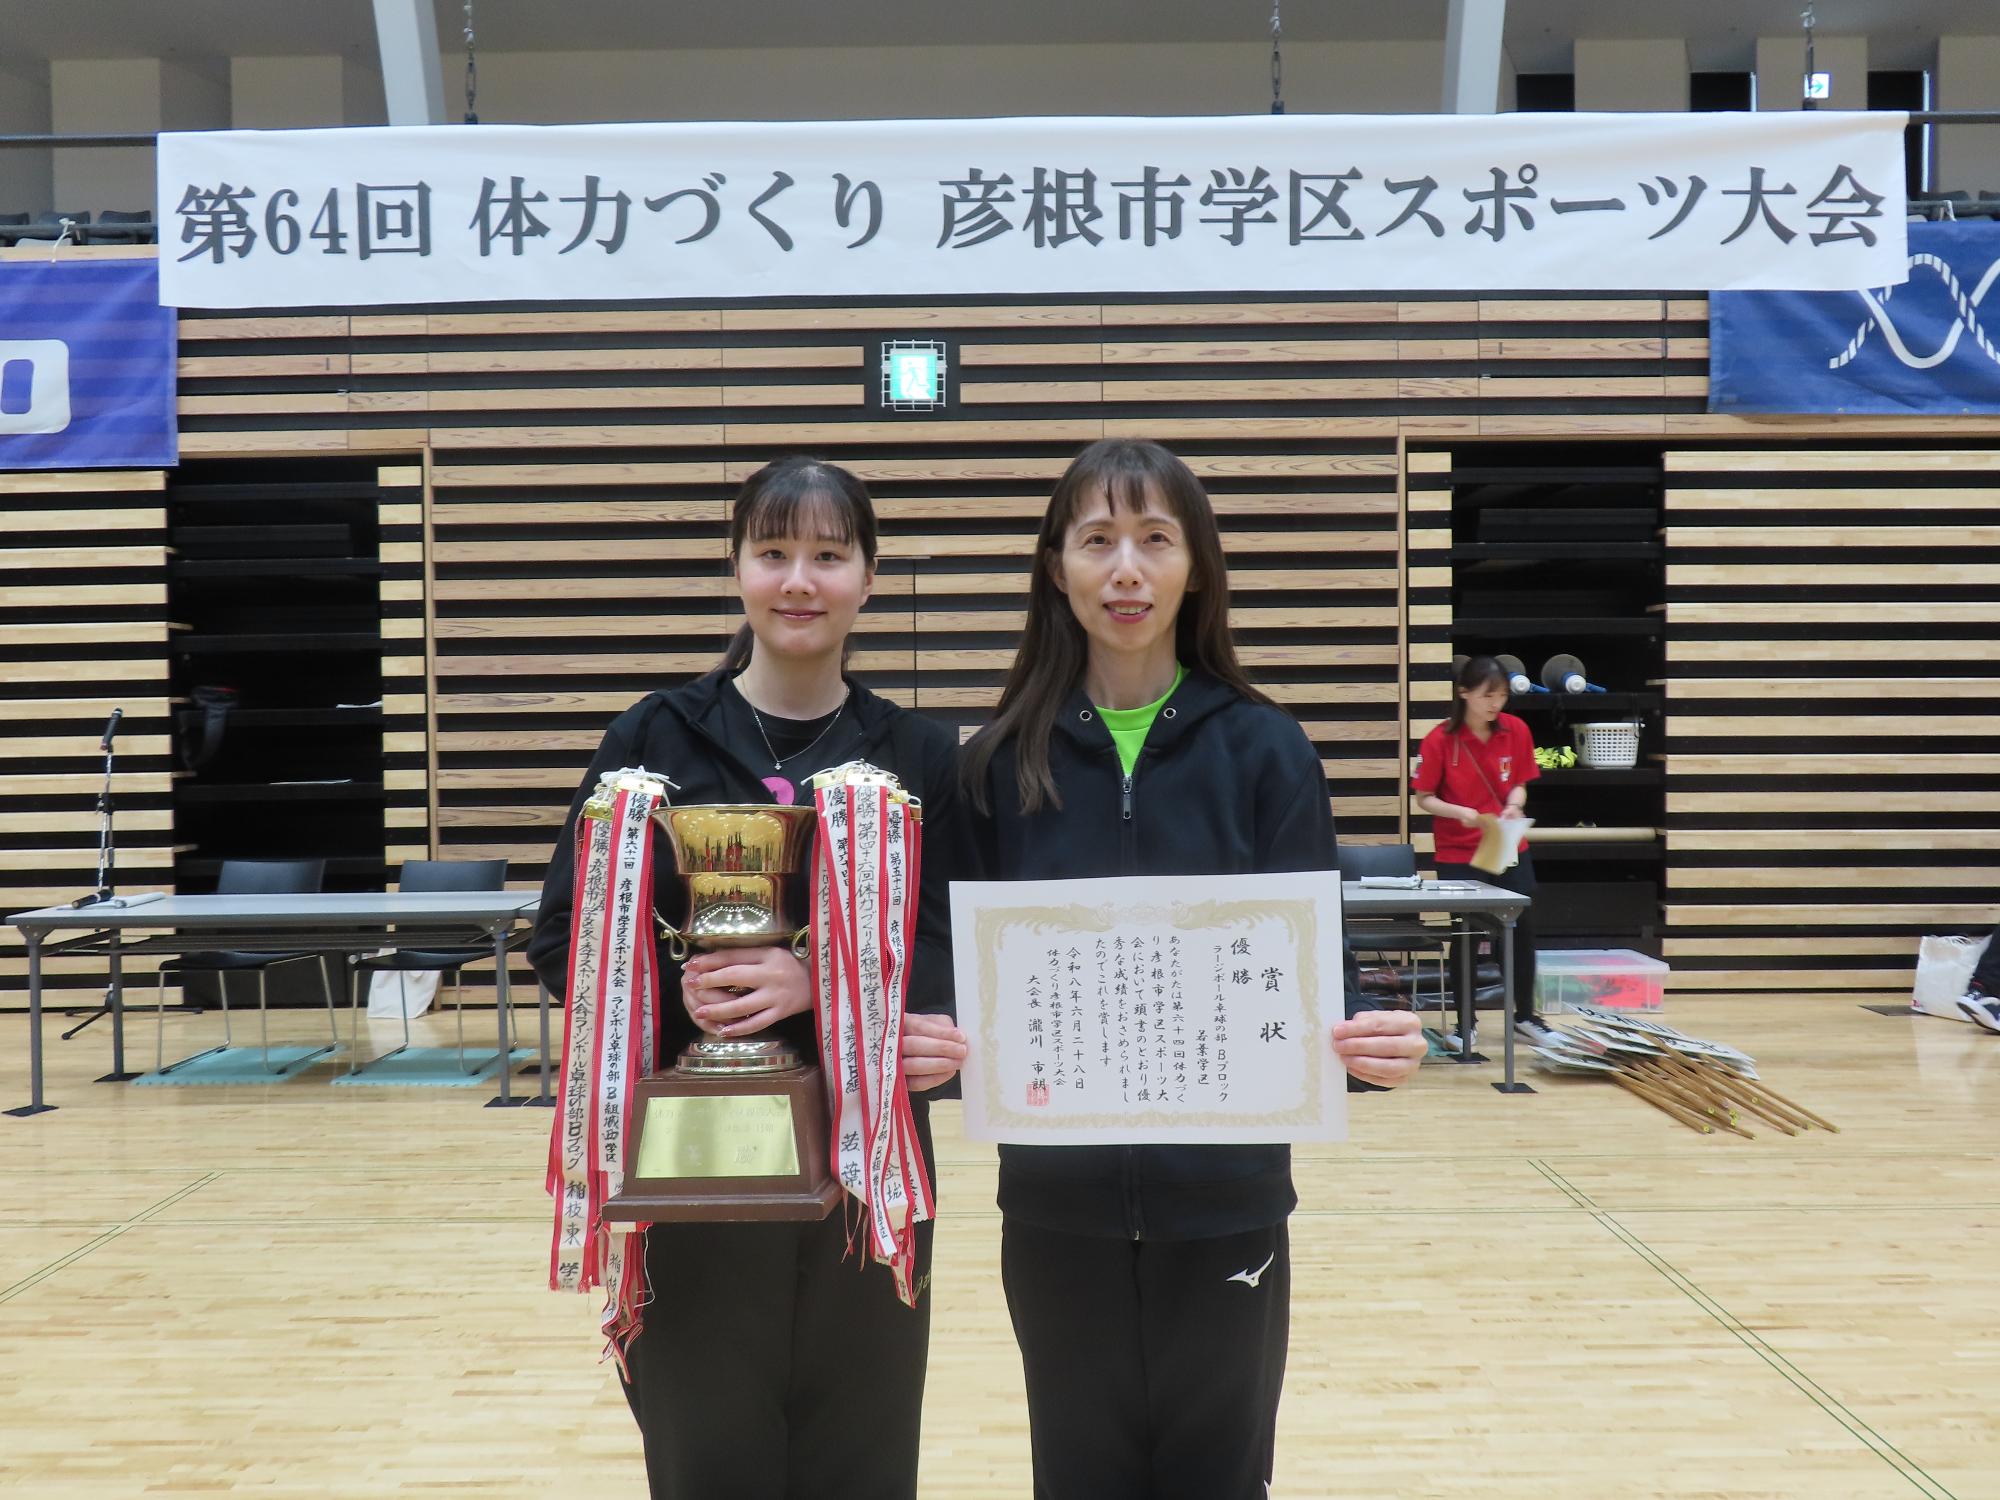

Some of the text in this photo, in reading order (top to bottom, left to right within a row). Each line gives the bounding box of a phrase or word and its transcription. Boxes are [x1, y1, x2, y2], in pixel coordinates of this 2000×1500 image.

[176, 163, 1886, 264] 第64回 体力づくり 彦根市学区スポーツ大会
[1230, 936, 1254, 986] 優勝
[1195, 1029, 1210, 1086] 若葉学区
